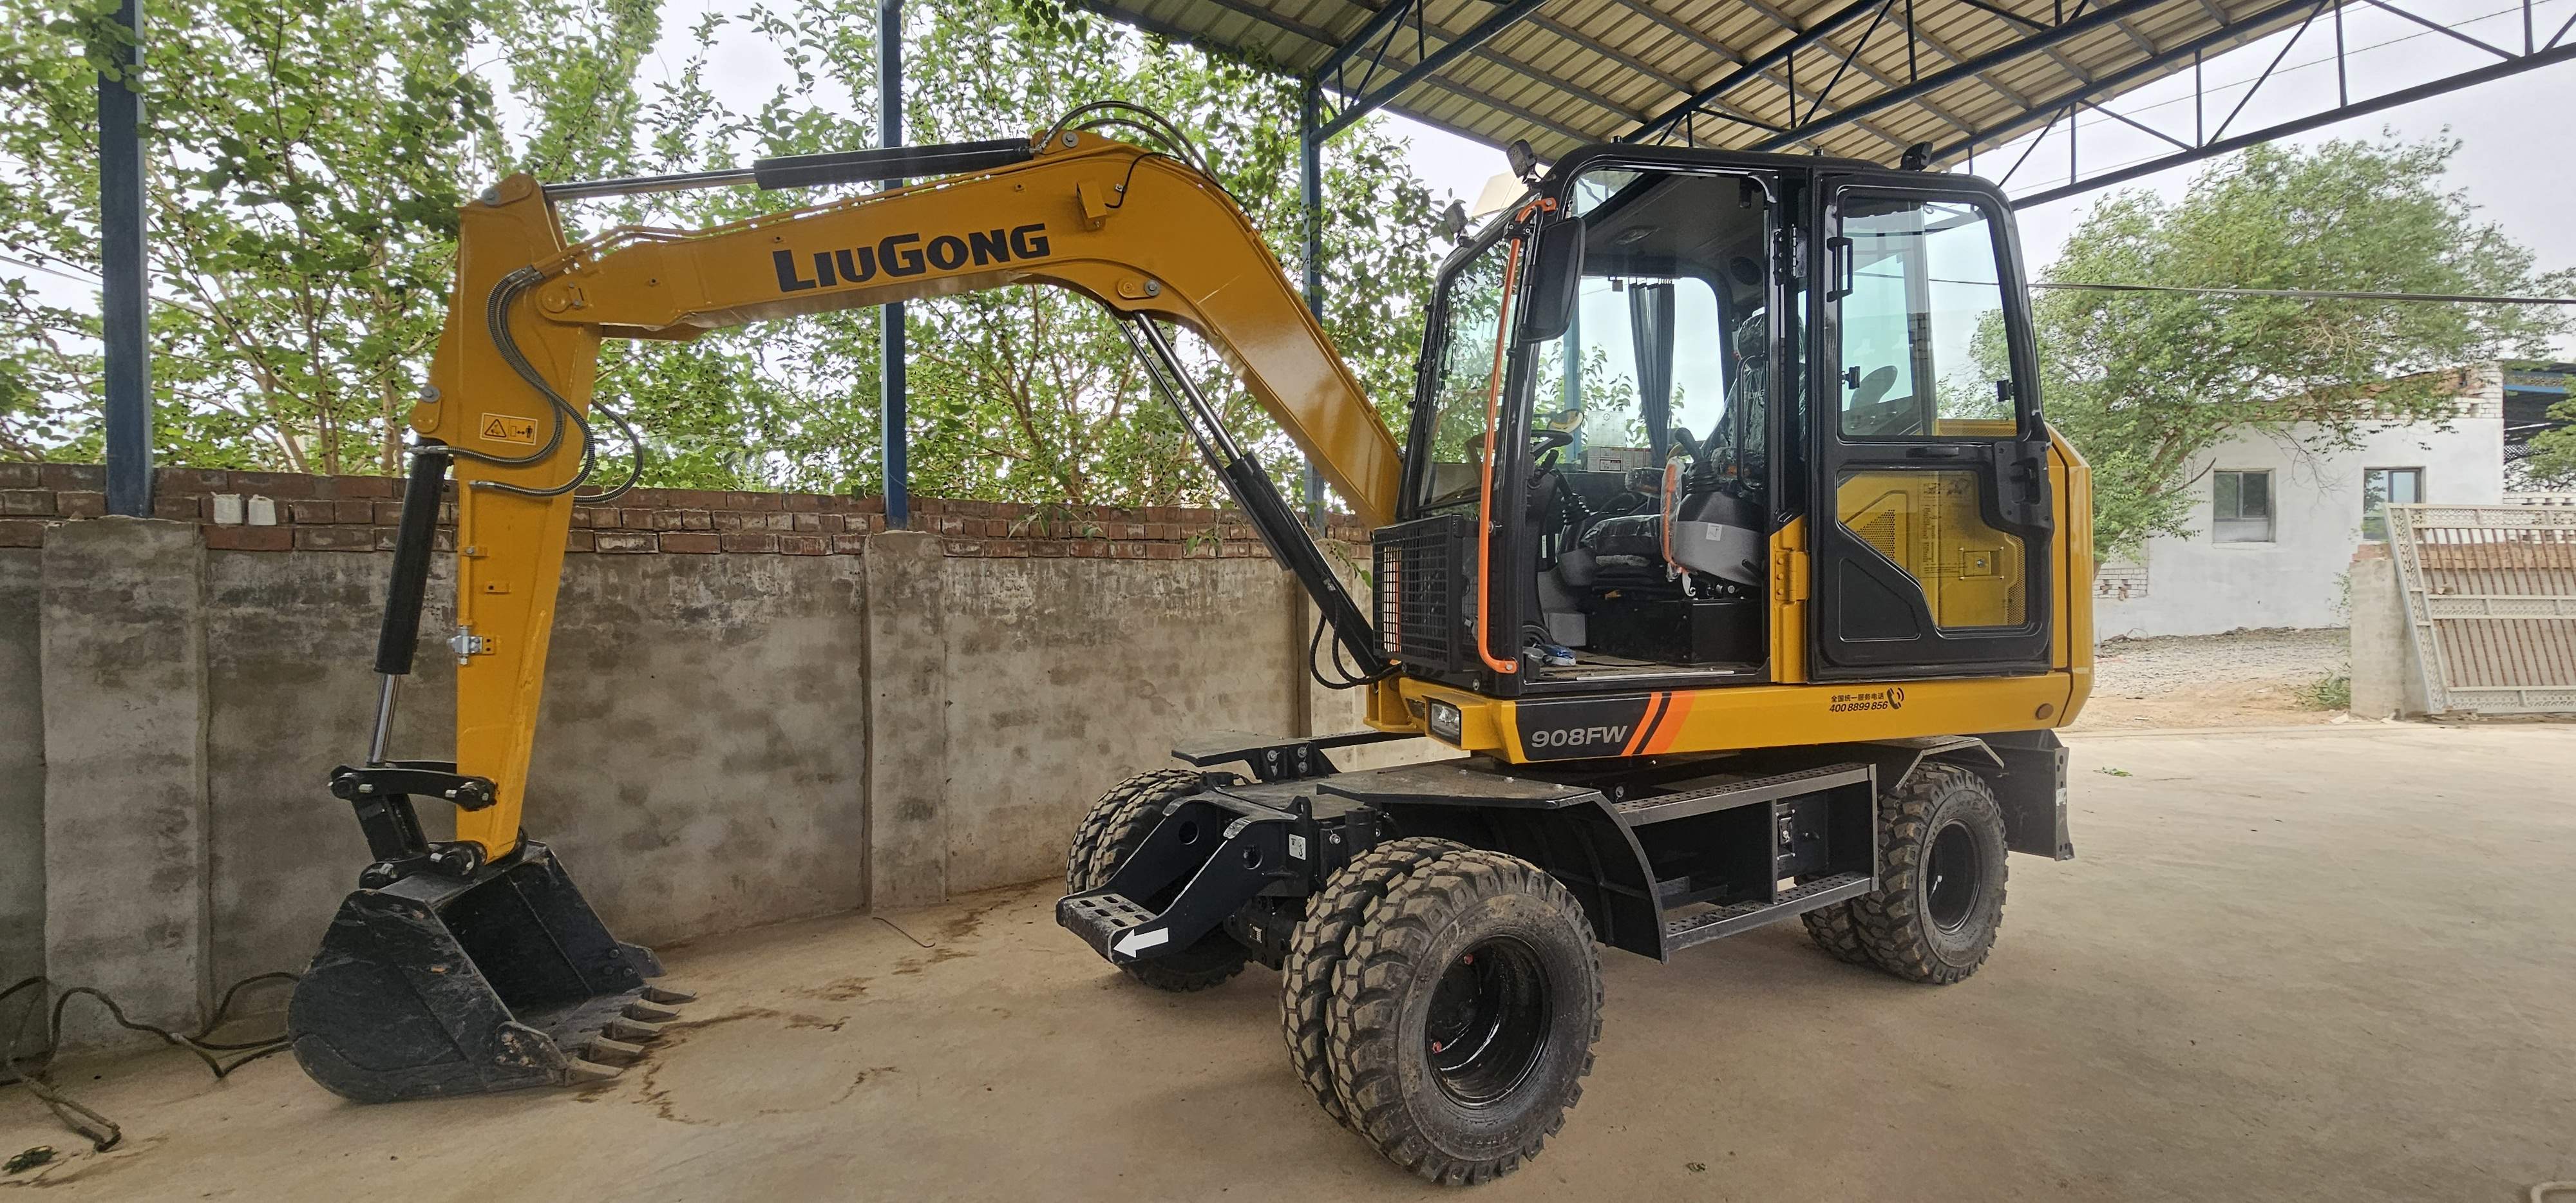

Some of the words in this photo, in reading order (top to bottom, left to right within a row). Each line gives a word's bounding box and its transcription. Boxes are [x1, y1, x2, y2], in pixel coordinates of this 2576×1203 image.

[1831, 692, 1884, 703] 全国统一服务电话
[1829, 703, 1847, 713] 400
[1847, 702, 1870, 712] 8899
[1871, 701, 1888, 710] 856
[1531, 725, 1628, 748] 908FW
